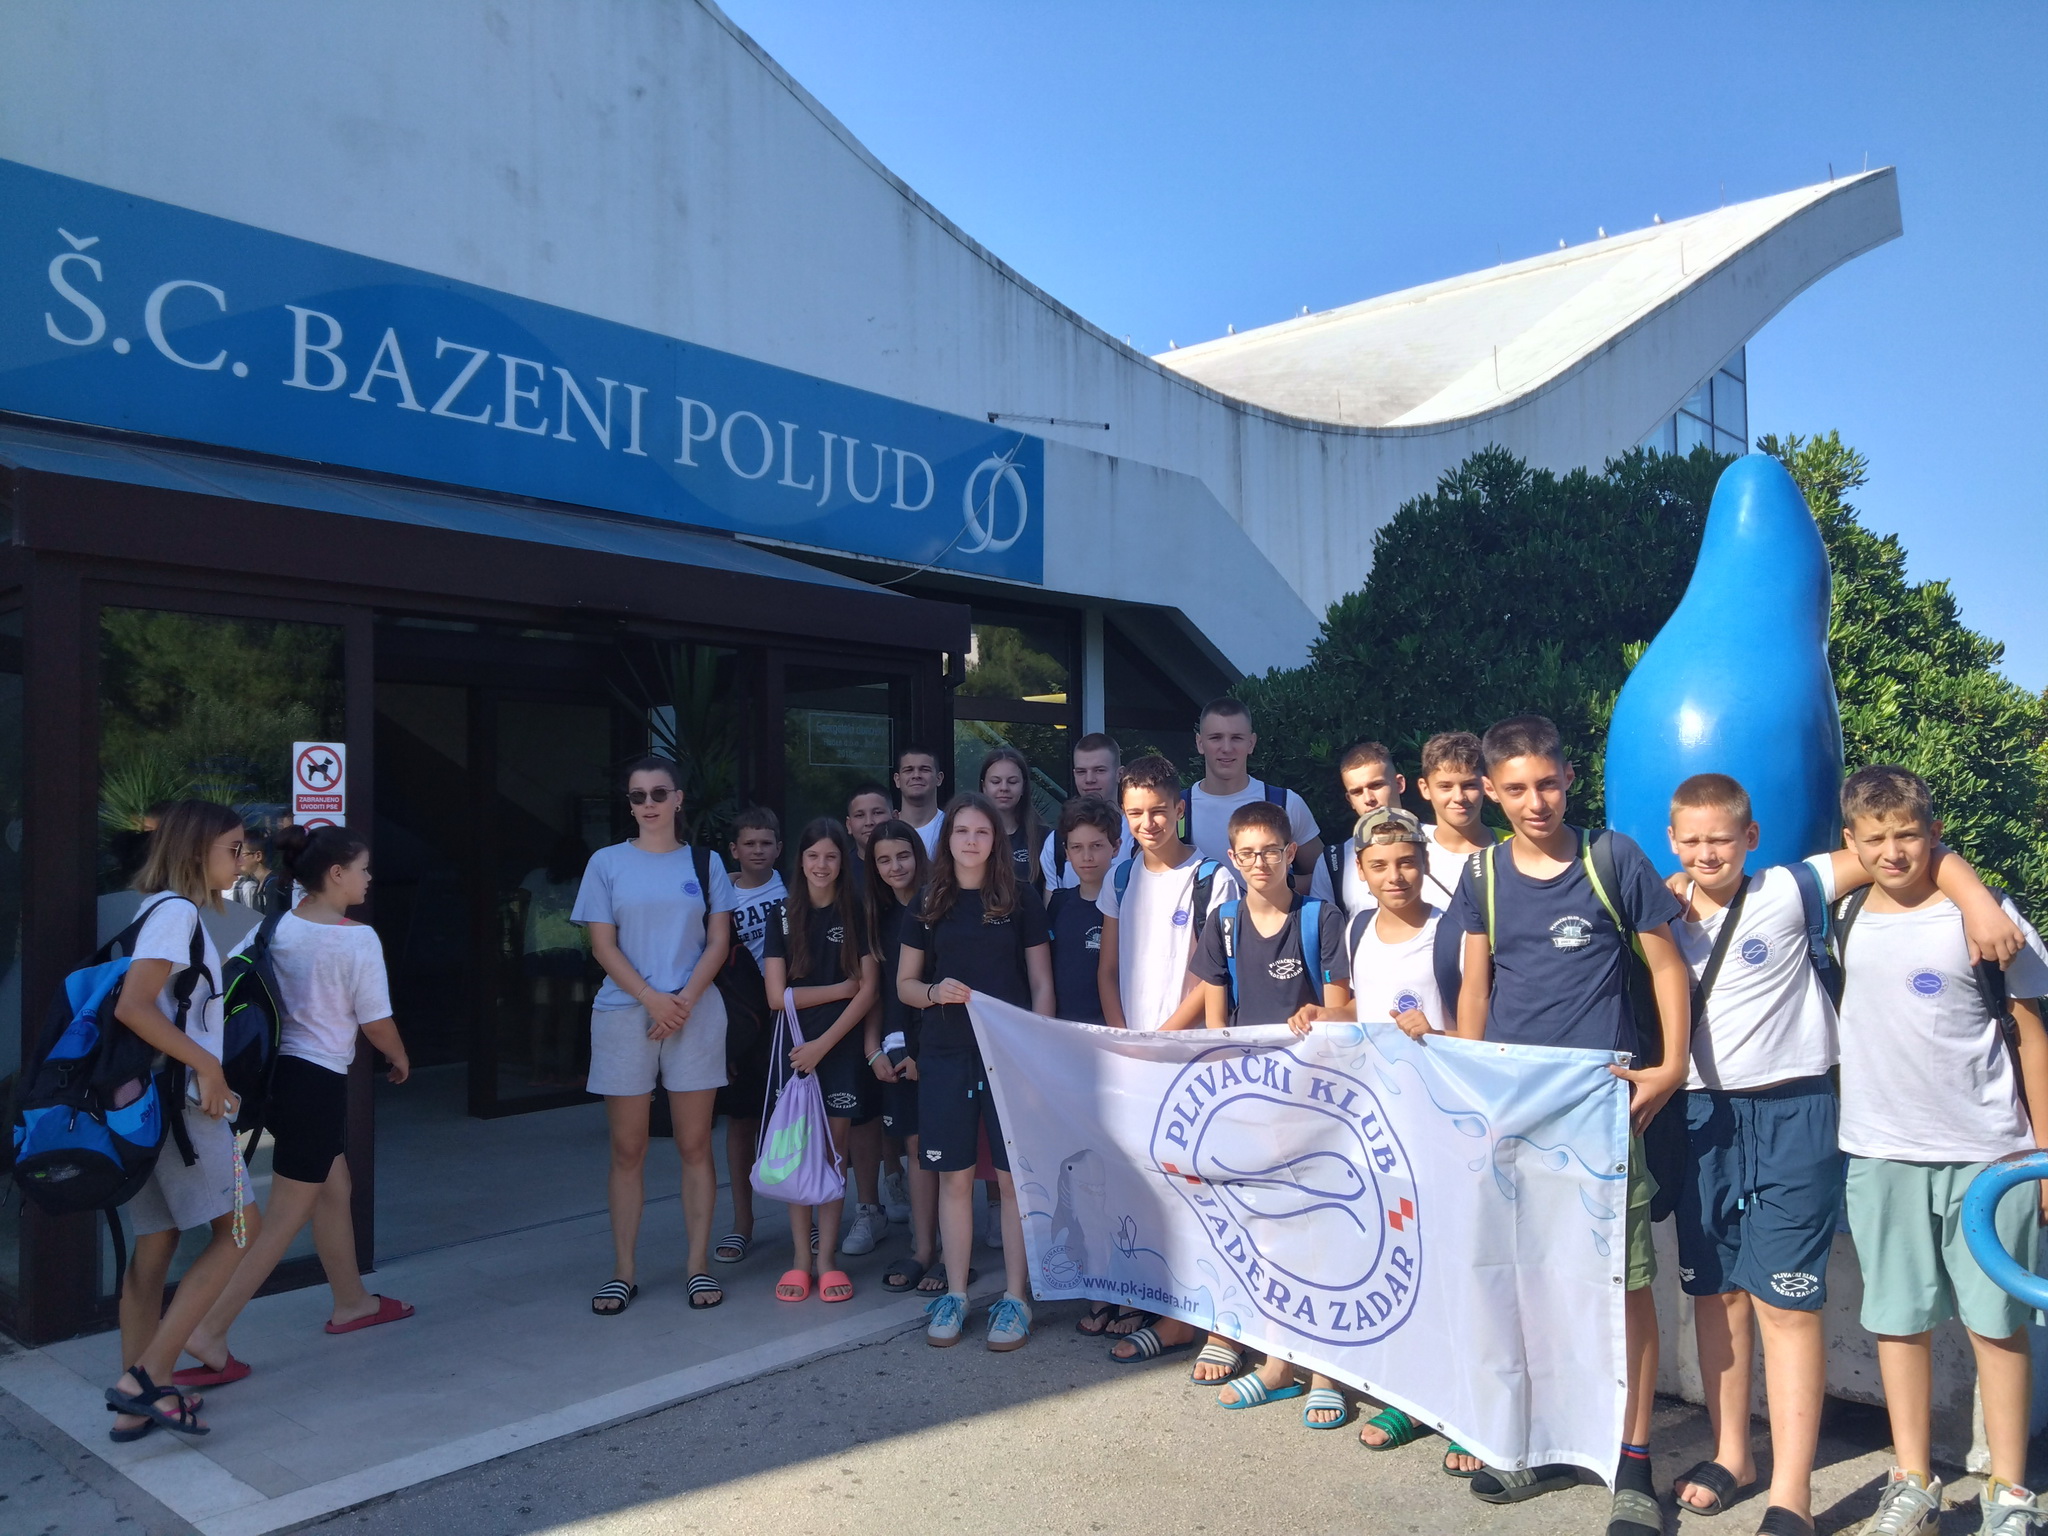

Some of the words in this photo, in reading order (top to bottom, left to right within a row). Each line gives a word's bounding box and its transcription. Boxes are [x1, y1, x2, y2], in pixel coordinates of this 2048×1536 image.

[44, 227, 249, 378] Š.C.
[282, 303, 648, 457] BAZENI
[674, 395, 935, 512] POLJUD
[1165, 1048, 1293, 1151] PLIVAČKI
[1307, 1076, 1398, 1174] KLUB
[1083, 1276, 1200, 1313] www.pk-jadera.hr
[1193, 1193, 1318, 1327] JADERA
[1328, 1245, 1414, 1333] ZADAR
